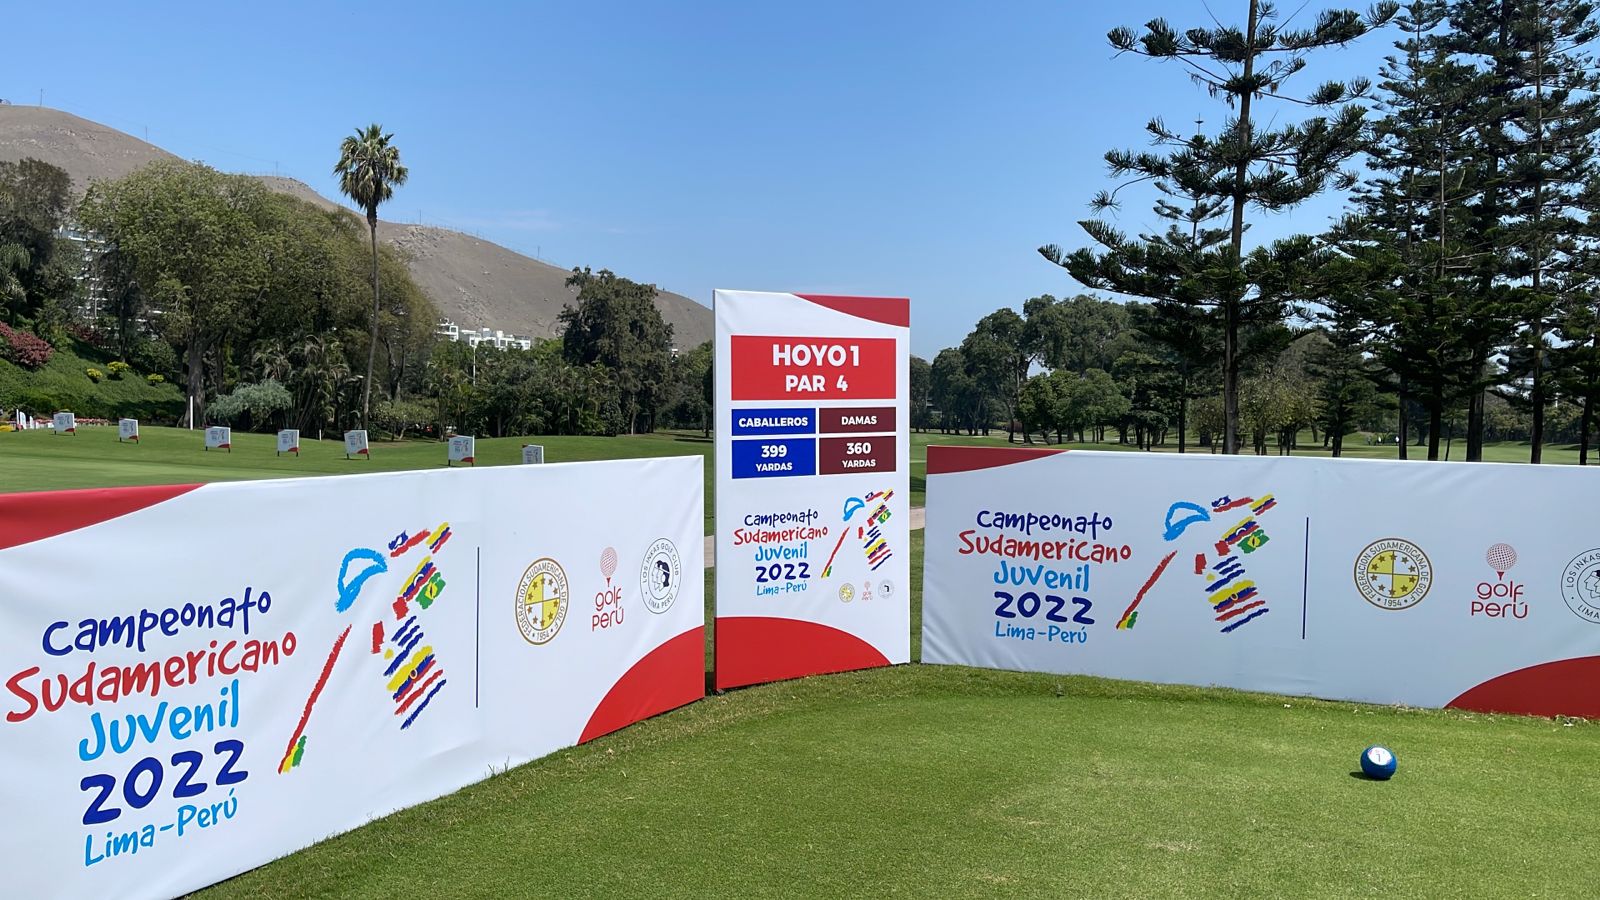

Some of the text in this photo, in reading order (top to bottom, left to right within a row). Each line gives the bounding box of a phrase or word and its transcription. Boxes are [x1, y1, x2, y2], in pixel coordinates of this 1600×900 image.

[786, 375, 848, 392] PAR 4
[738, 417, 808, 428] CABALLEROS
[841, 415, 877, 425] DAMAS
[761, 445, 787, 458] 399
[846, 442, 871, 455] 360
[756, 462, 792, 471] YARDAS
[842, 459, 876, 468] YARDAS
[734, 526, 828, 545] Sudamericano
[755, 541, 807, 561] Juvenil
[958, 529, 1131, 564] Sudamericano
[755, 562, 810, 583] 2022
[993, 560, 1089, 592] Juvenil
[1357, 541, 1429, 602] FEDERACION SUDAMERICANA DE GOLF
[1566, 570, 1577, 588] LOS
[756, 580, 807, 596] Lima-Perú
[1476, 580, 1524, 602] golf
[517, 562, 567, 637] FEDERACION SUDAMERICANA DE GOLF
[595, 586, 622, 611] golf
[994, 591, 1095, 624] 2022
[1383, 598, 1402, 607] 1954
[1577, 604, 1600, 619] LIMA
[536, 630, 550, 641] 1954
[995, 621, 1087, 643] Lima-Perú
[5, 632, 297, 722] Sudamericano
[79, 679, 239, 761] Juvenil
[80, 739, 248, 825] 2022
[85, 788, 238, 866] Lima-Perú
